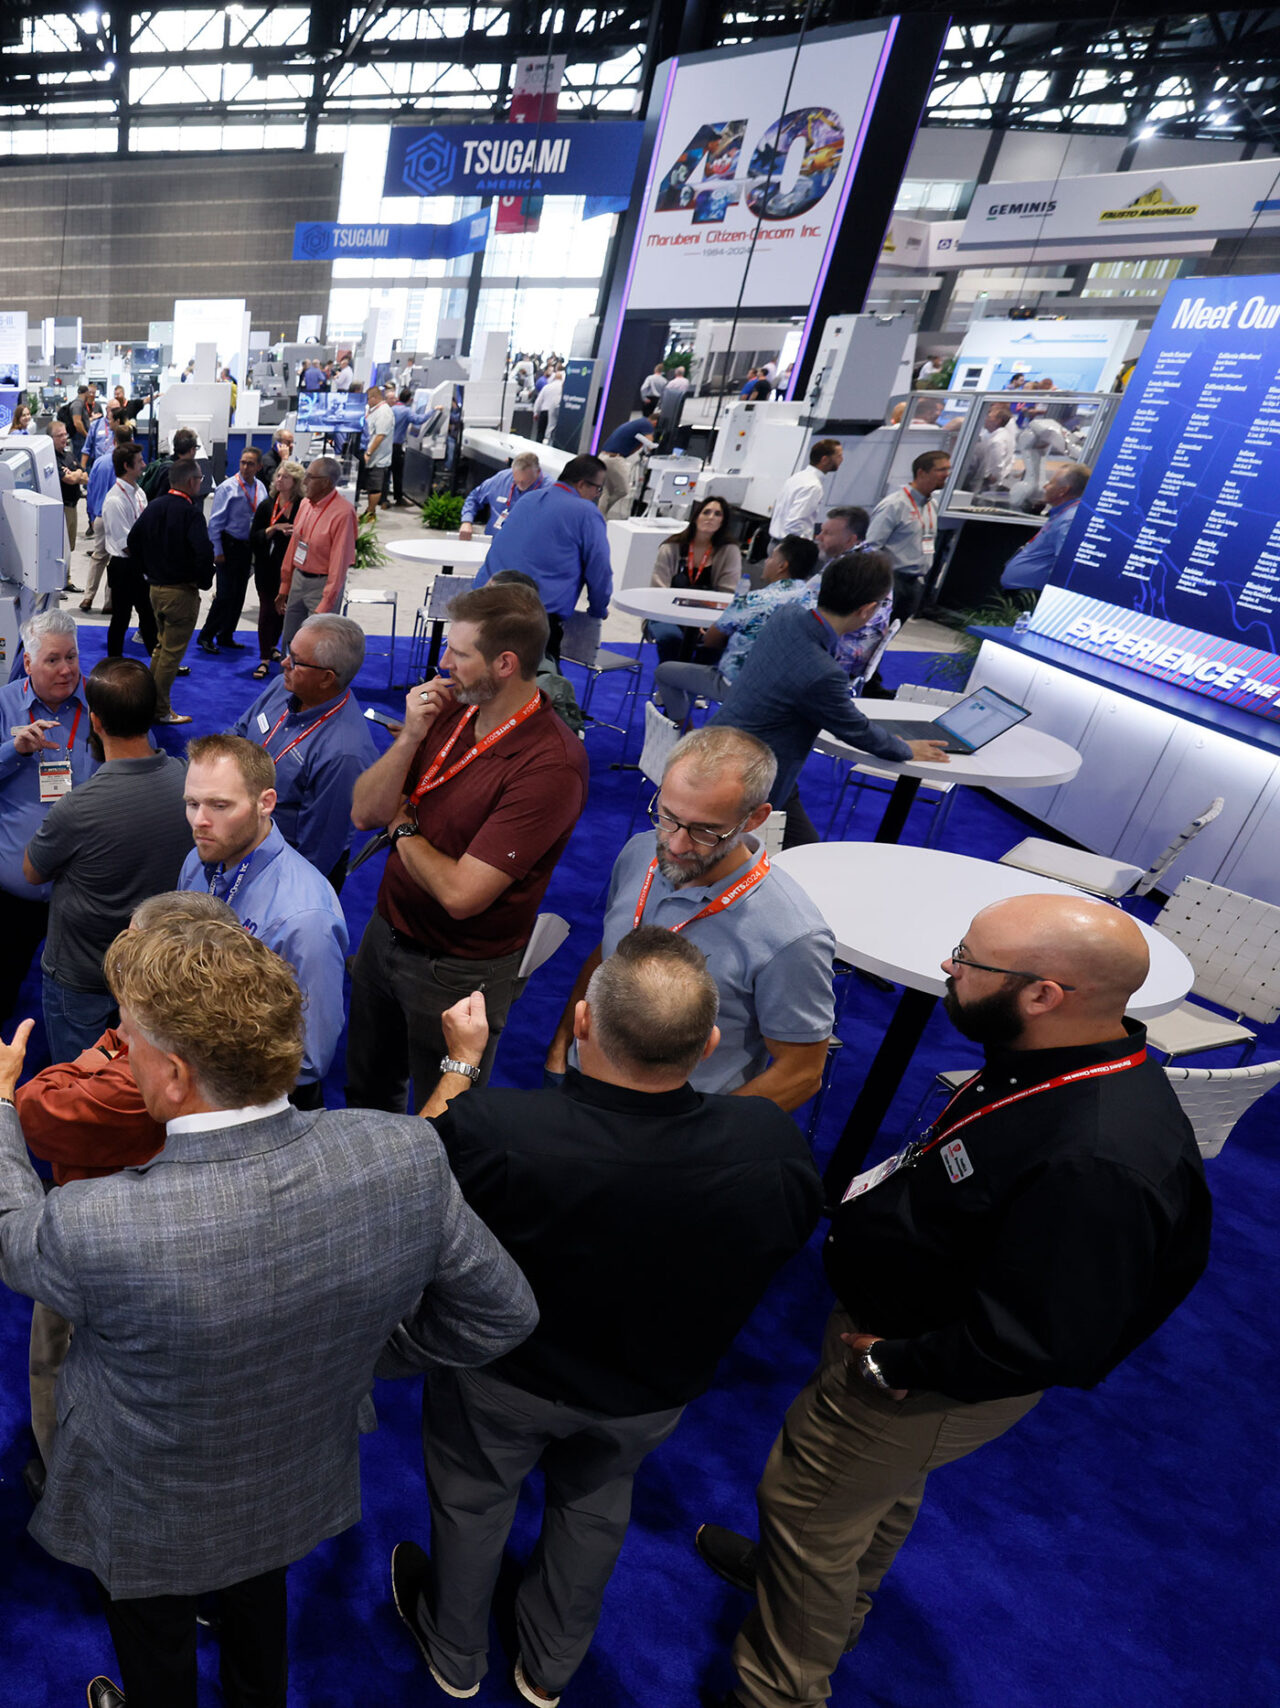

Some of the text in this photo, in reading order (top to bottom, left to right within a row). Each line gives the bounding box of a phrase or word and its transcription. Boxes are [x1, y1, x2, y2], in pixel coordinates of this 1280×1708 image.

[463, 138, 571, 175] TSUGAMI
[654, 106, 845, 226] 40
[476, 179, 542, 190] AMERICA
[332, 228, 390, 249] TSUGAMI
[647, 232, 701, 247] Marubeni
[1171, 297, 1238, 330] Meet
[1065, 616, 1249, 691] EXPERIENCE
[728, 869, 761, 900] IMTS2024
